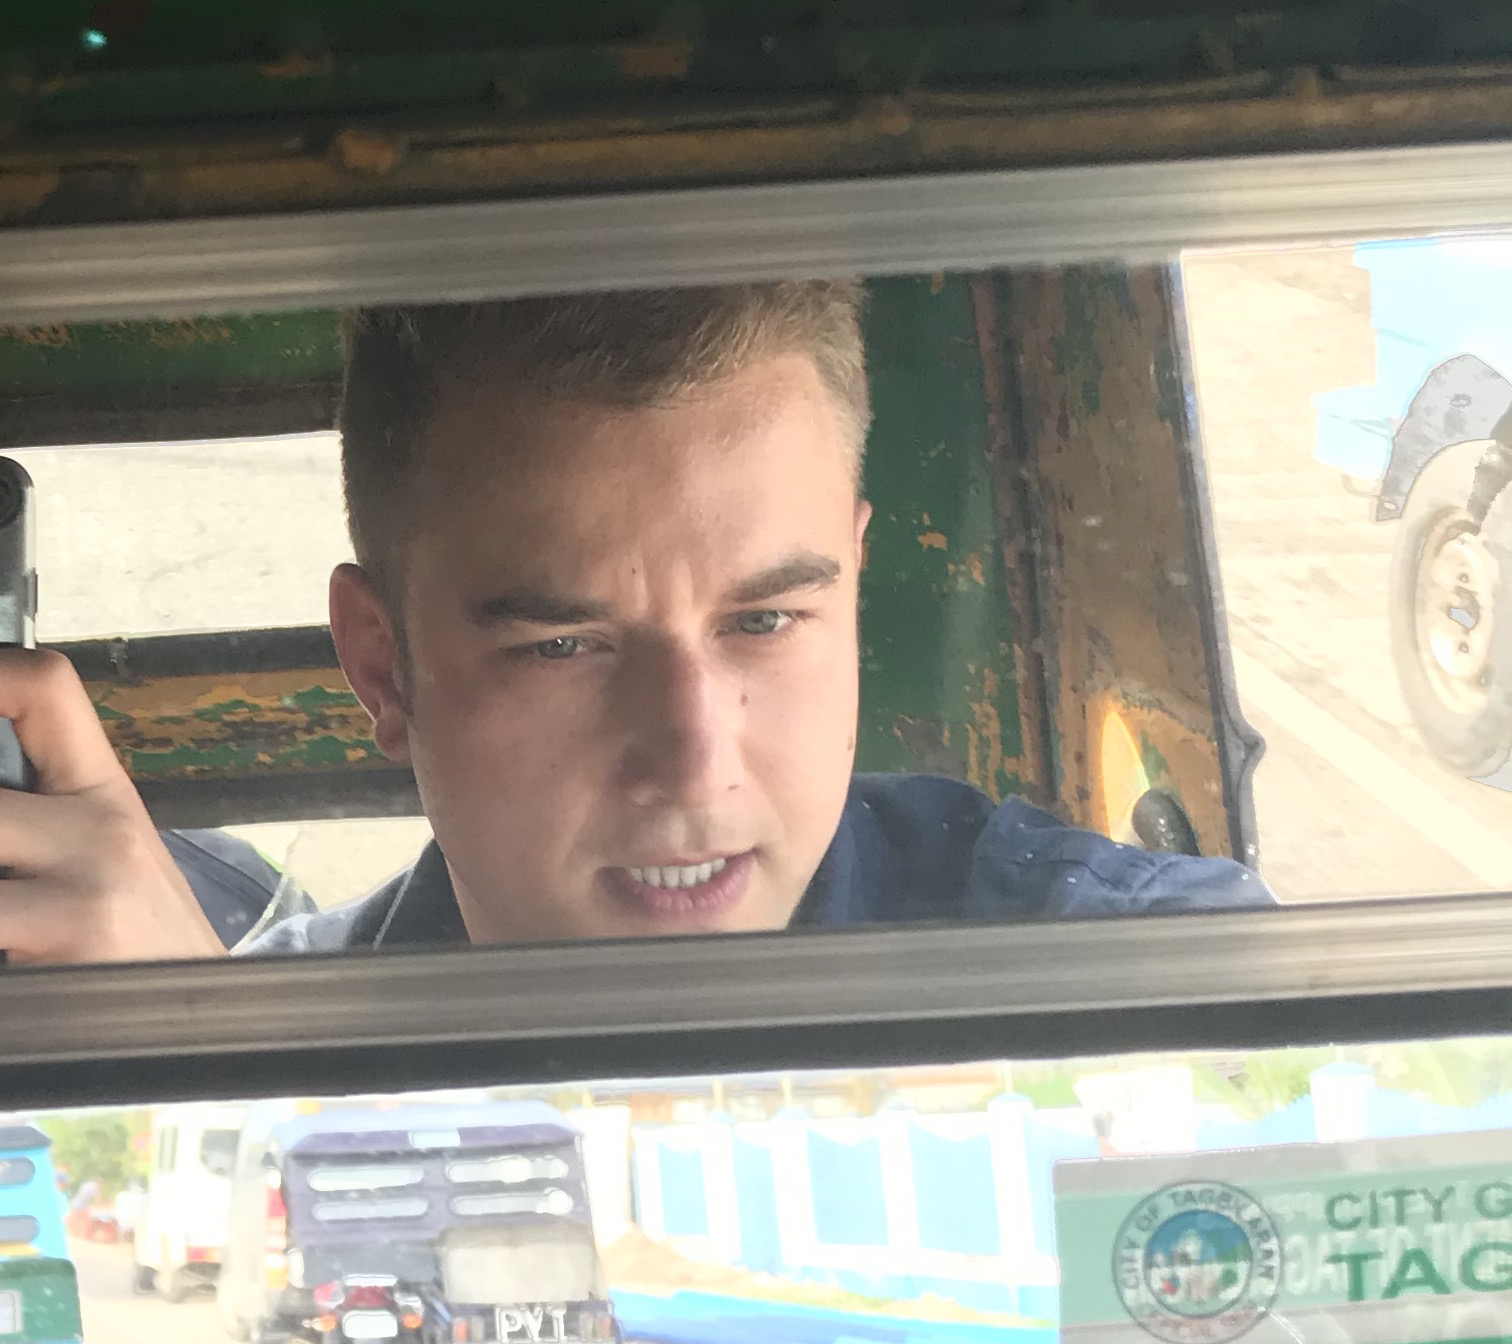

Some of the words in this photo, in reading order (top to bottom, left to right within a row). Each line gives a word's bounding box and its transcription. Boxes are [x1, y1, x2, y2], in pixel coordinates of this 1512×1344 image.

[1324, 1184, 1452, 1232] CITY
[1323, 1240, 1512, 1303] TAG
[495, 1306, 567, 1344] PVT
